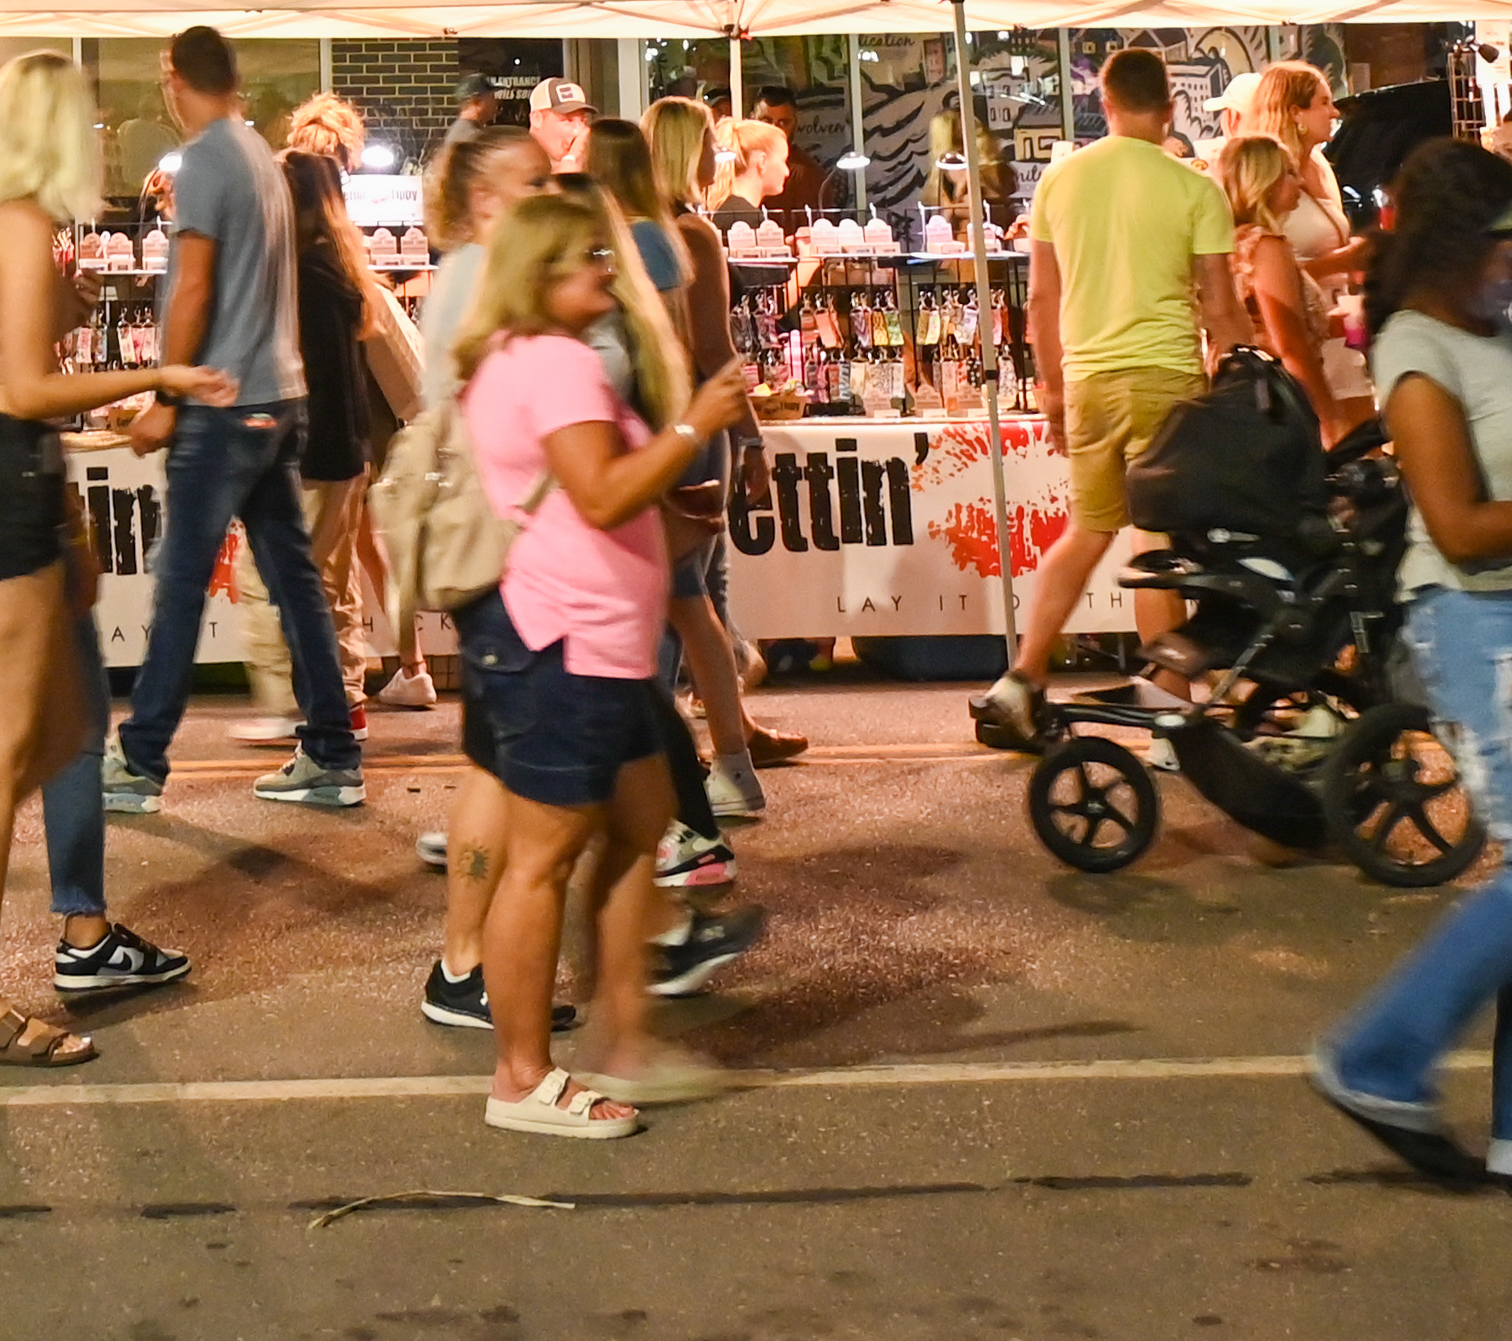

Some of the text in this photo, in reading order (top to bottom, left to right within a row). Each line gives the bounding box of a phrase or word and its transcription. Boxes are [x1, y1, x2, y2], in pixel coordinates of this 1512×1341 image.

[728, 432, 929, 555] ettin'
[837, 595, 902, 613] LAY
[940, 593, 966, 611] IT
[111, 625, 151, 642] AY
